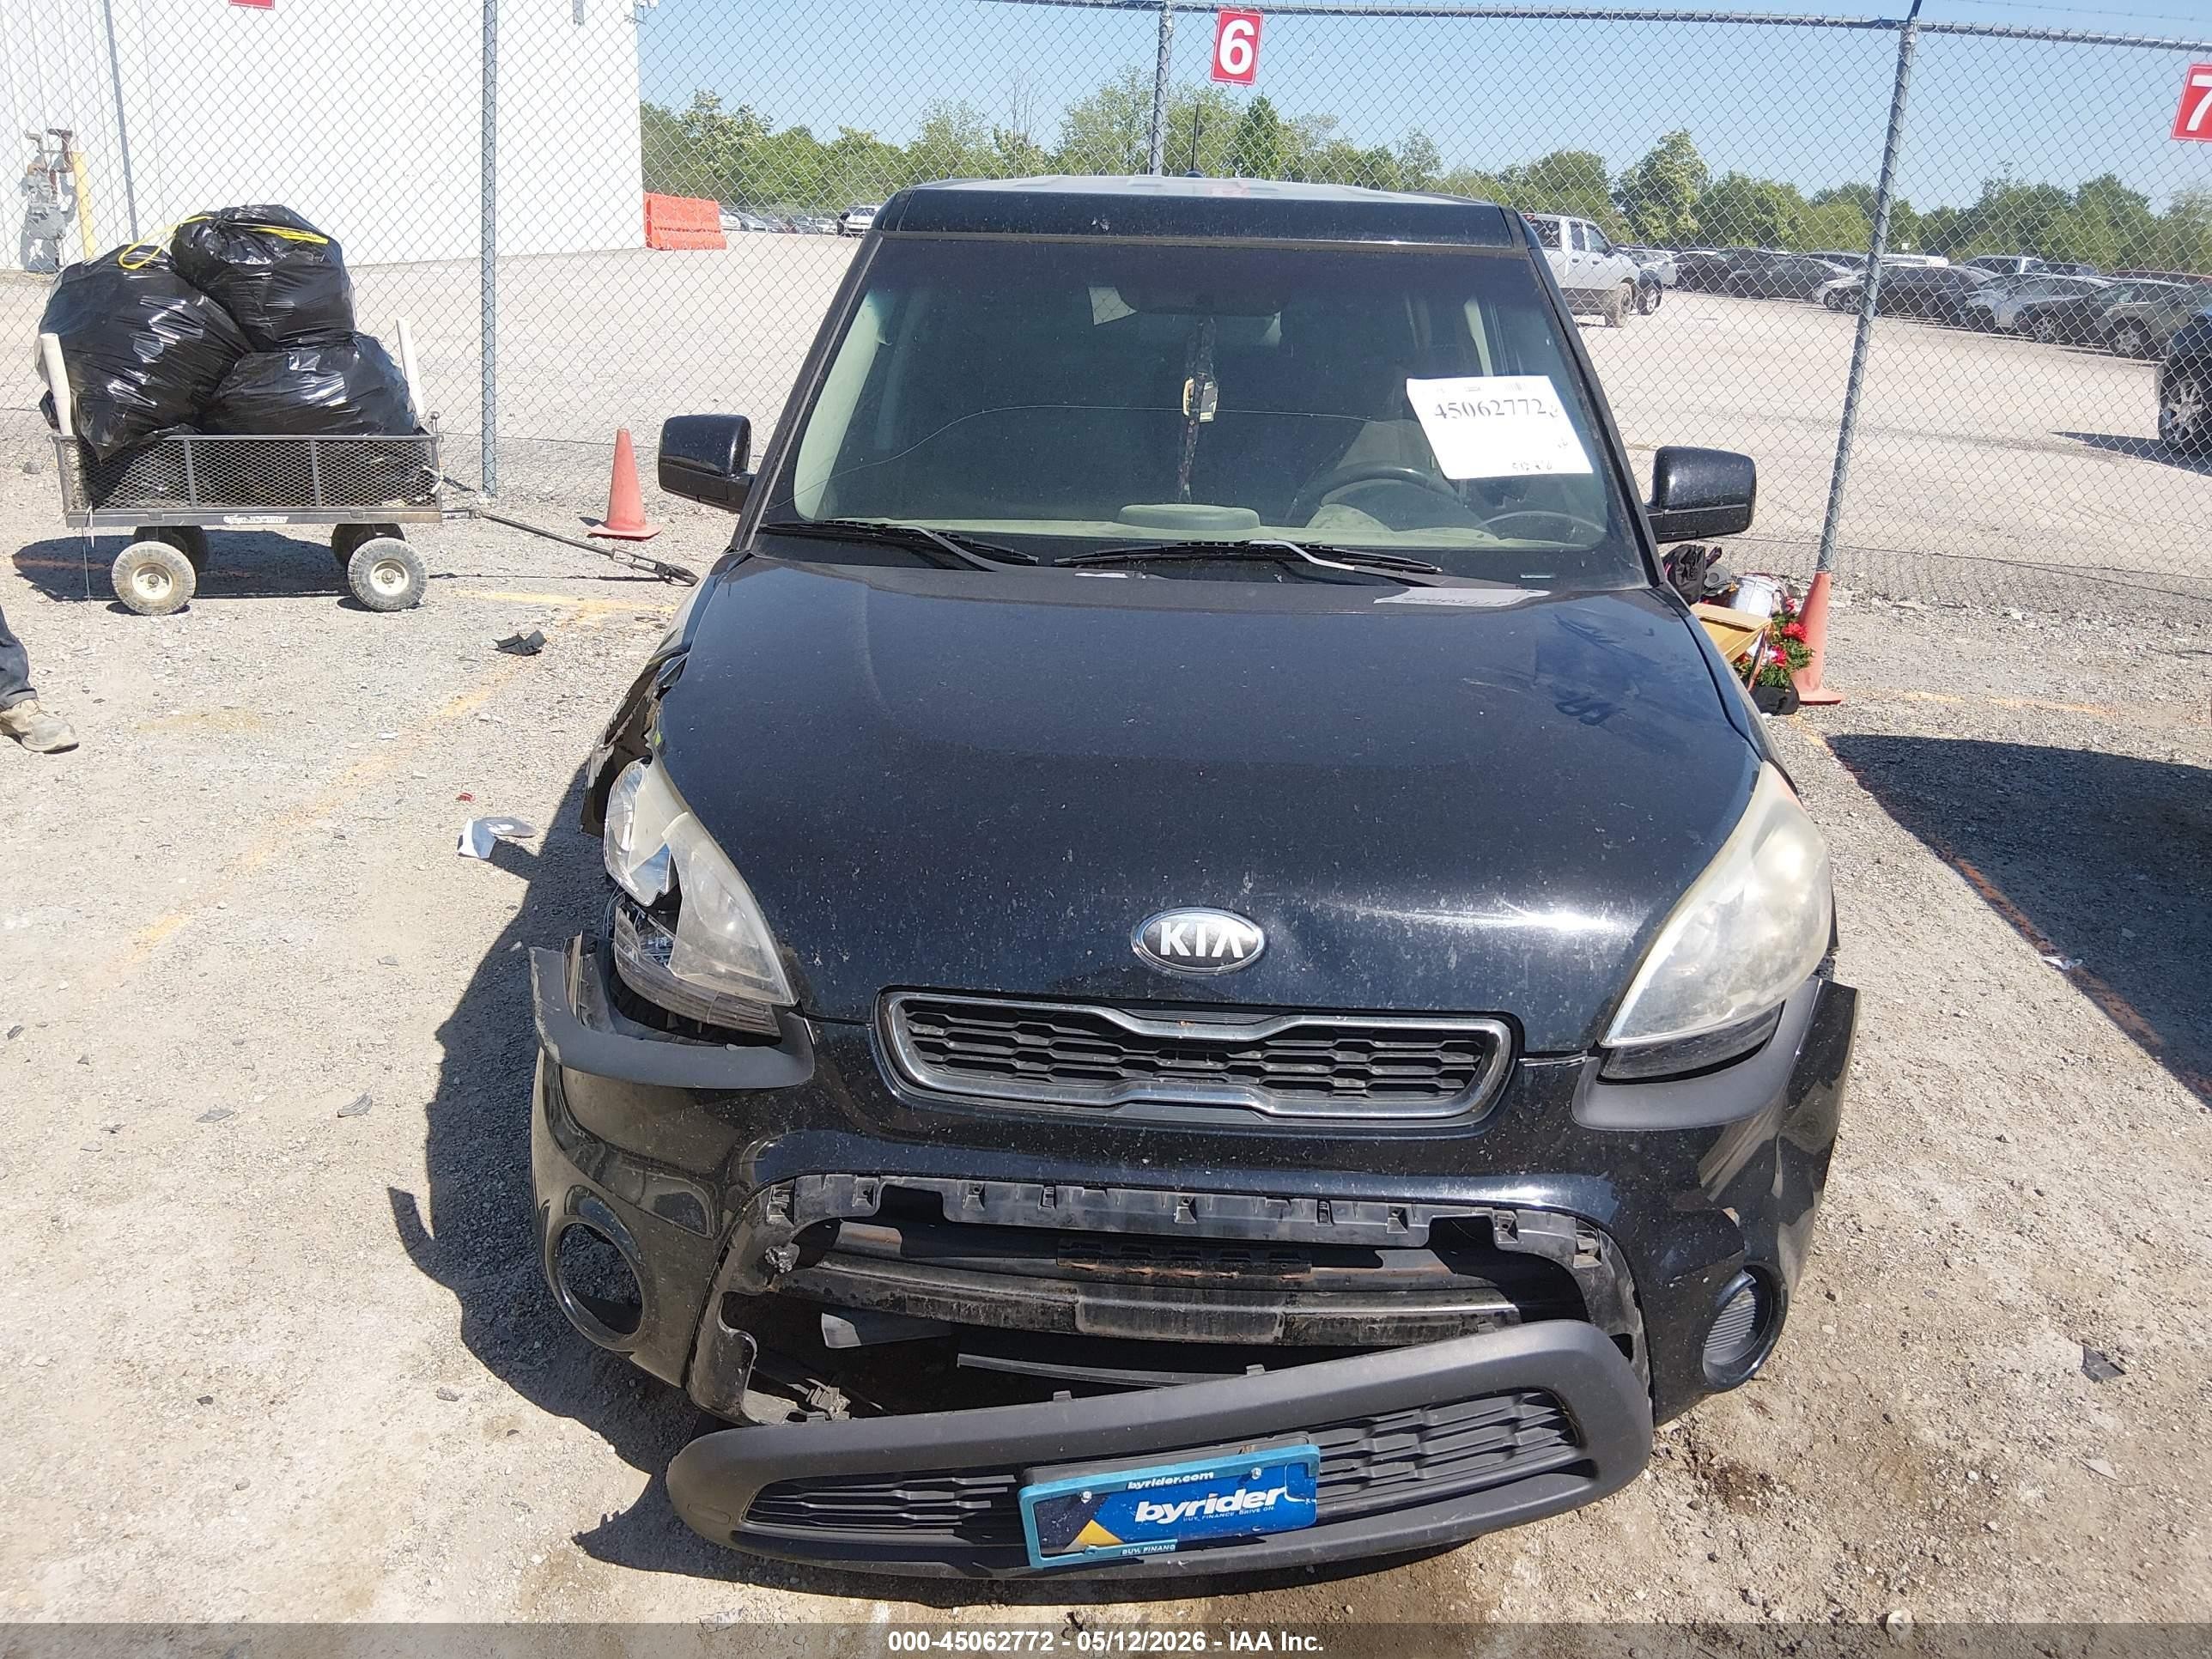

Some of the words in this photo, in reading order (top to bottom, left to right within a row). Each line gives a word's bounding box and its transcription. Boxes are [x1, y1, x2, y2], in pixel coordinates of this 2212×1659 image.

[1219, 19, 1255, 75] 6
[2186, 74, 2212, 131] 7
[1434, 398, 1547, 419] 45062772
[1160, 922, 1244, 958] KIA
[1127, 1472, 1214, 1490] byrider.com
[1135, 1486, 1287, 1524] byrider
[1239, 1507, 1261, 1516] DRIVE
